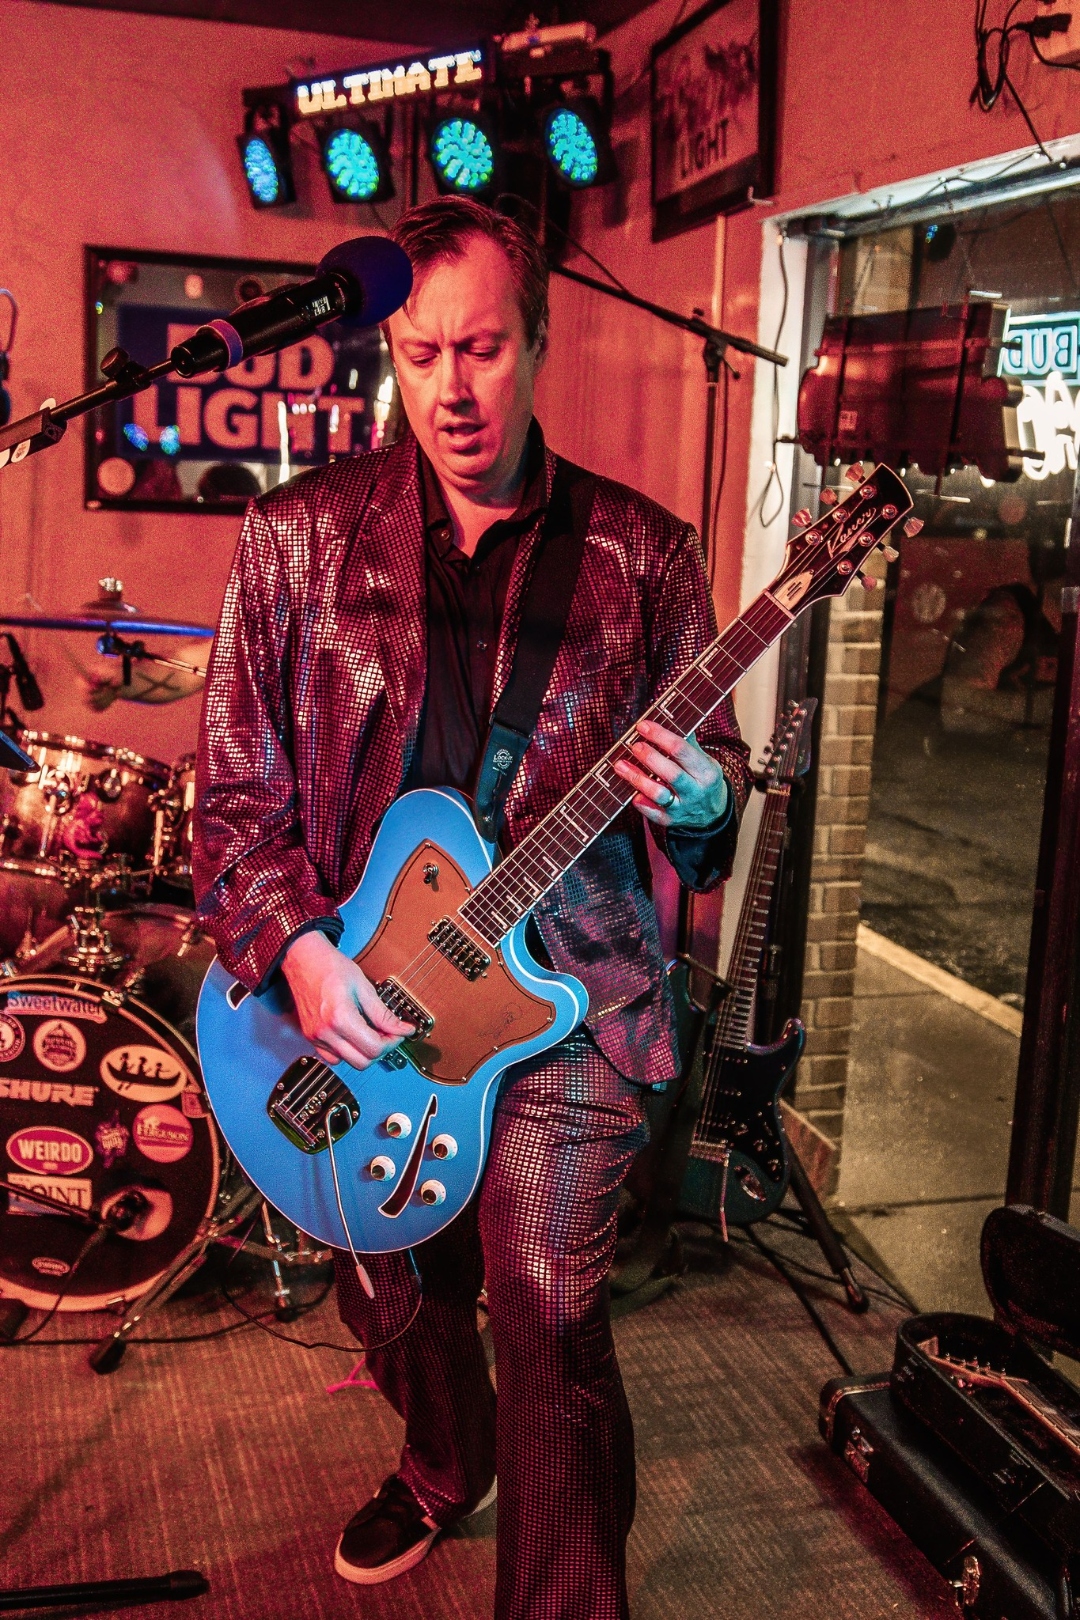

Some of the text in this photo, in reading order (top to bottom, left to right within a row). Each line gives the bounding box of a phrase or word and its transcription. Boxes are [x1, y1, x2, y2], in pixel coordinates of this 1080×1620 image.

[297, 50, 482, 114] ULTIMATE
[680, 117, 729, 179] LIGHT
[133, 382, 365, 454] LIGHT
[8, 992, 102, 1016] Sweetwater
[17, 1138, 82, 1164] WEIRDO
